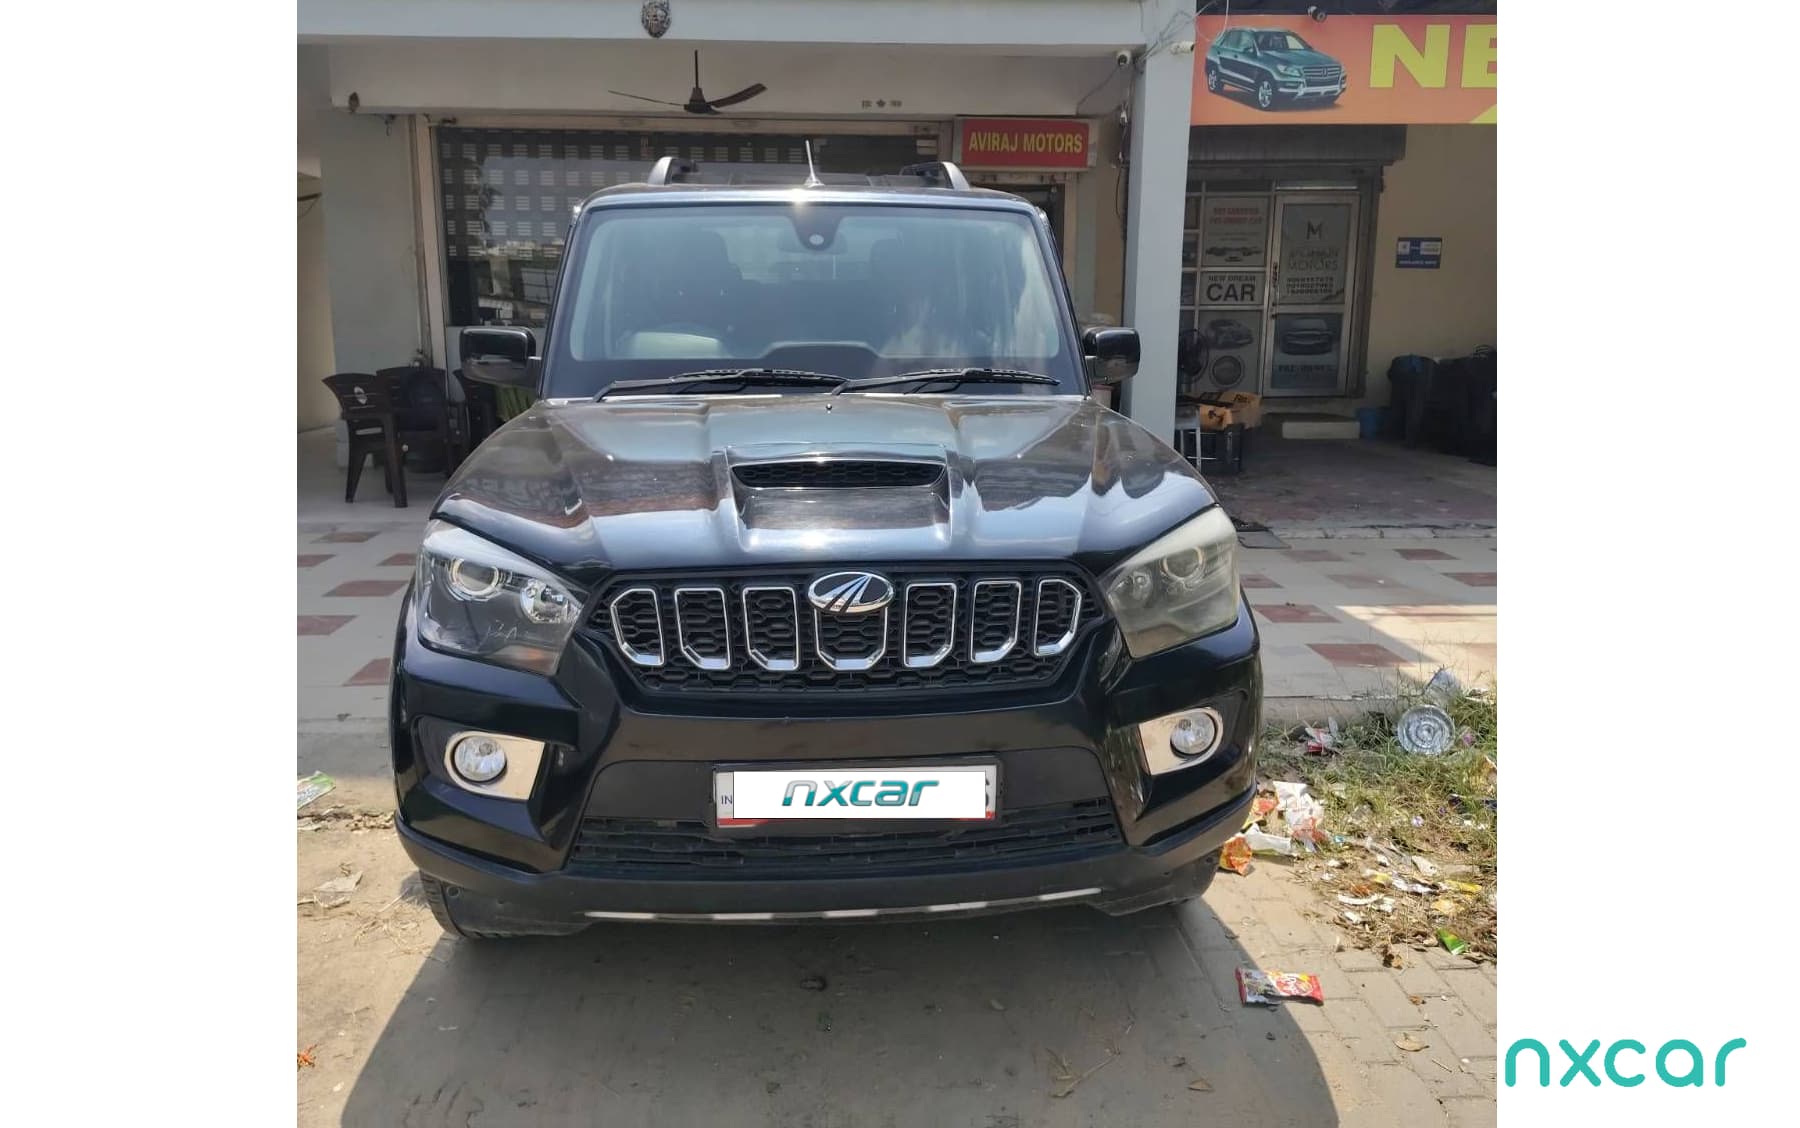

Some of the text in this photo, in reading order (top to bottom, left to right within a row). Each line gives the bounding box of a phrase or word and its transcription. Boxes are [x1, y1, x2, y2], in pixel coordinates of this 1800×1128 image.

[969, 132, 1083, 153] AVIRAJ MOTORS
[1206, 283, 1256, 301] CAR
